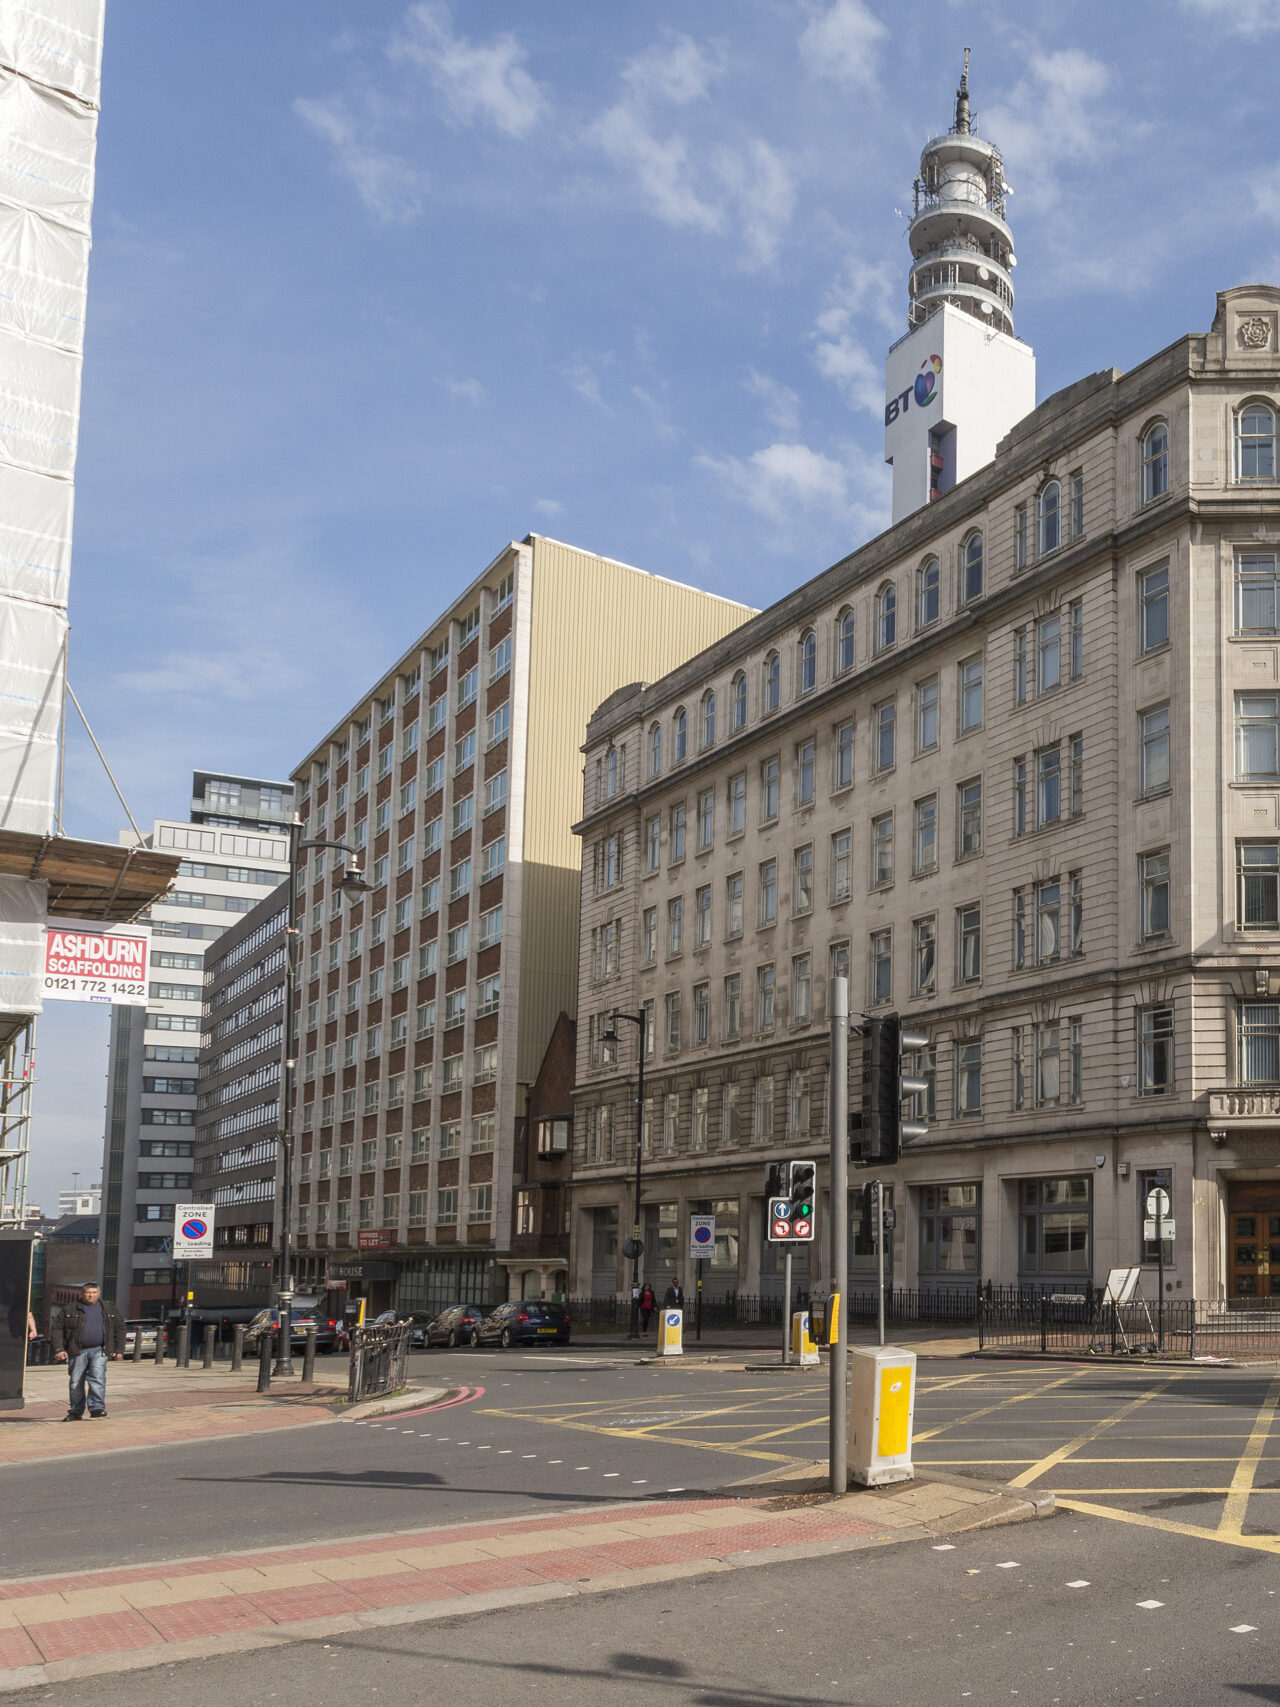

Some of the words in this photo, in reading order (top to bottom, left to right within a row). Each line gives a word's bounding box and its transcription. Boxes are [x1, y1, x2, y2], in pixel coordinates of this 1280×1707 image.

[885, 386, 914, 427] BT
[49, 934, 143, 964] ASHDURN
[48, 958, 142, 979] SCAFFOLDING
[44, 977, 76, 990] 0121
[80, 980, 107, 992] 772
[112, 983, 145, 996] 1422
